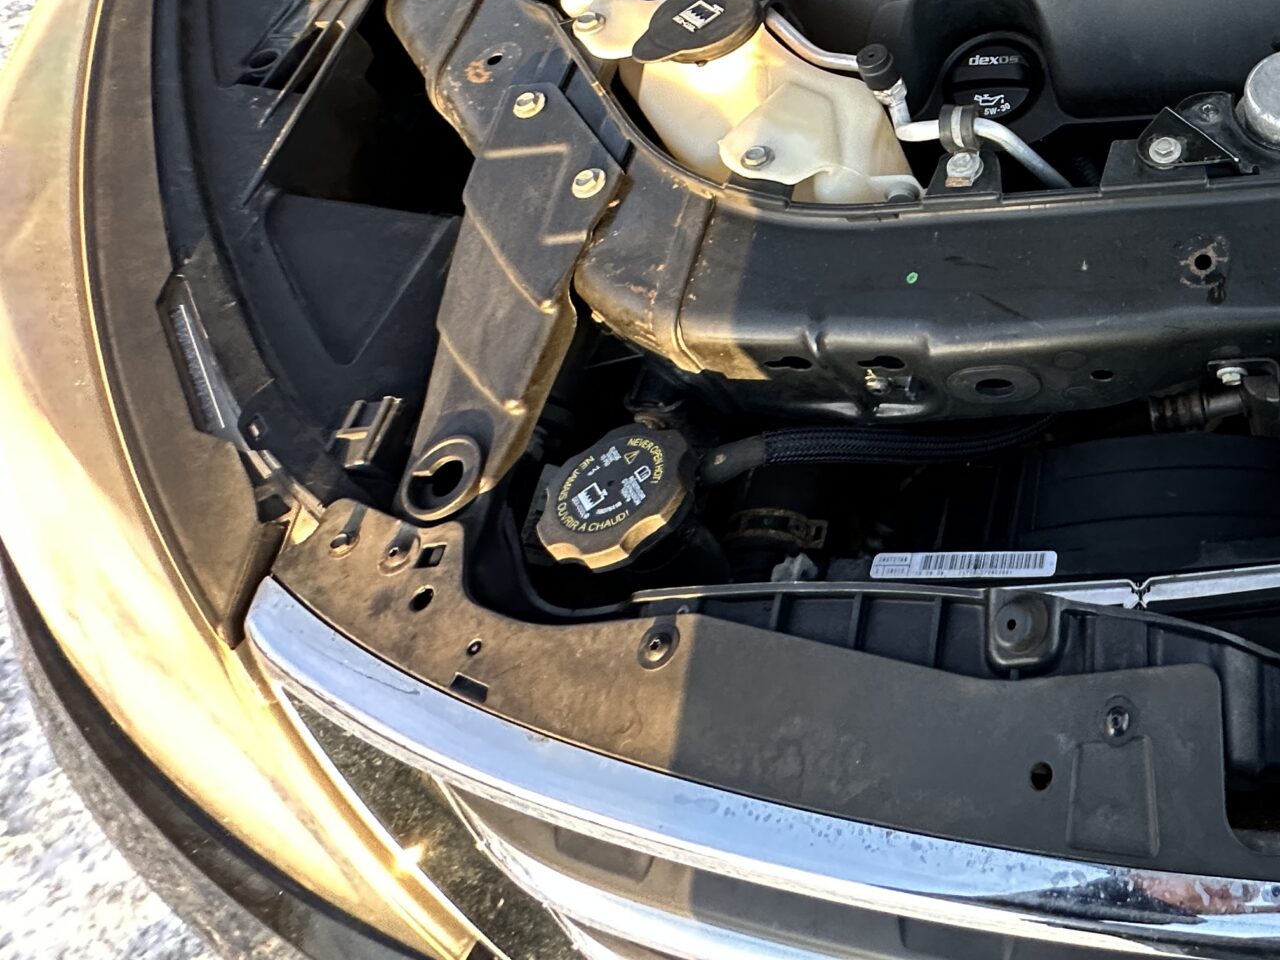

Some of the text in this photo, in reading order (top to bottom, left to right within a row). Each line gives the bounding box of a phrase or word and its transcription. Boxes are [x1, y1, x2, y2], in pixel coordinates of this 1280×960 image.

[968, 55, 1019, 65] dexos
[984, 103, 1011, 115] 5W-30
[579, 455, 595, 470] NE
[627, 438, 664, 483] NEVER OPEN HOT!
[558, 468, 580, 501] JAMAIS
[557, 502, 580, 531] OUVRIR
[588, 509, 630, 532] CHAUD!
